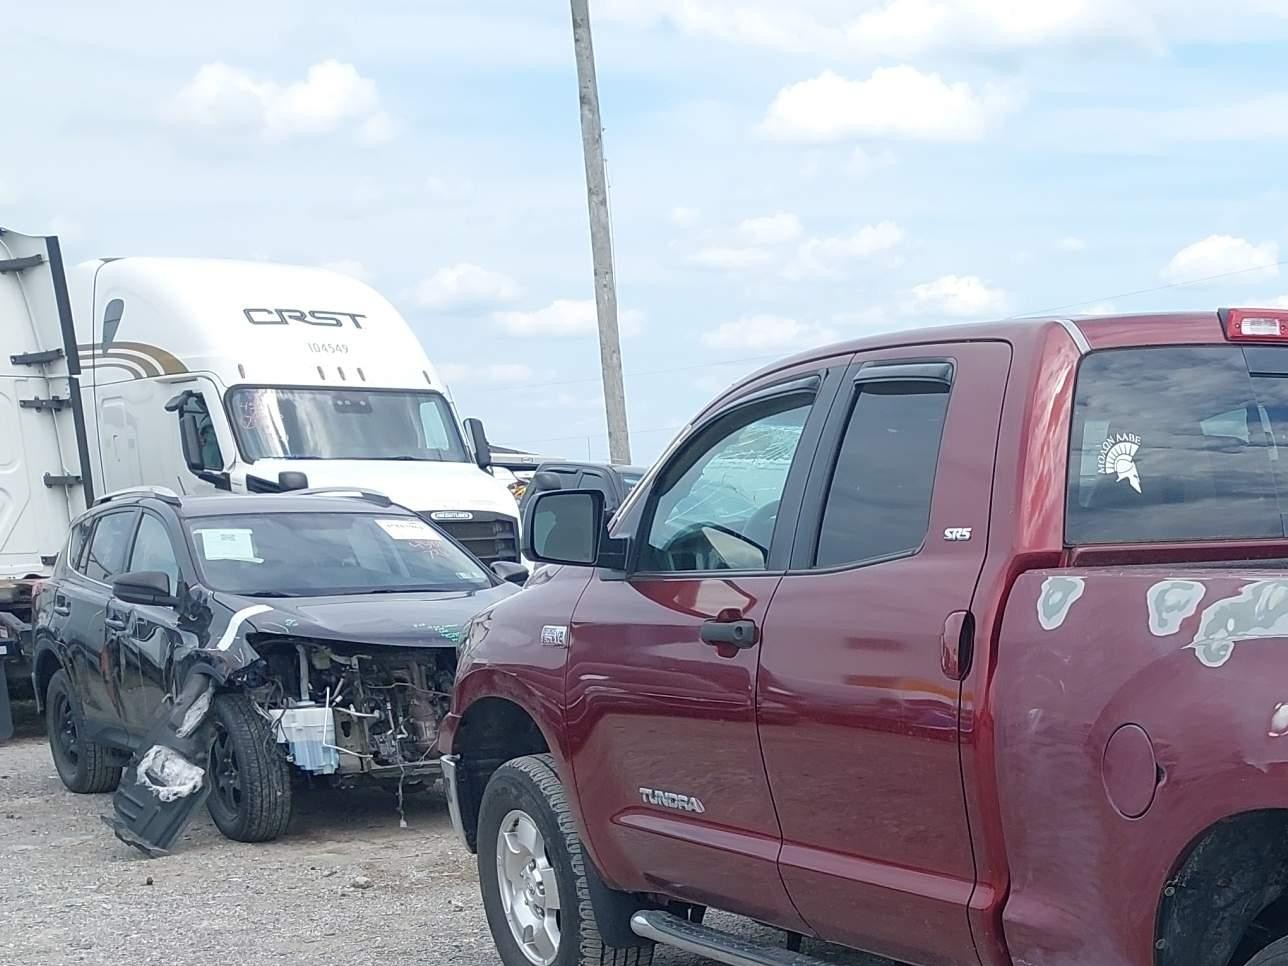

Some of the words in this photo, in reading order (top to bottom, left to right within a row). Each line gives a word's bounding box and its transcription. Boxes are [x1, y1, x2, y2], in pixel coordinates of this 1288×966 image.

[243, 308, 367, 329] CRST
[307, 342, 349, 354] 104549
[943, 527, 972, 541] SR5
[639, 787, 705, 813] TUNDRA
